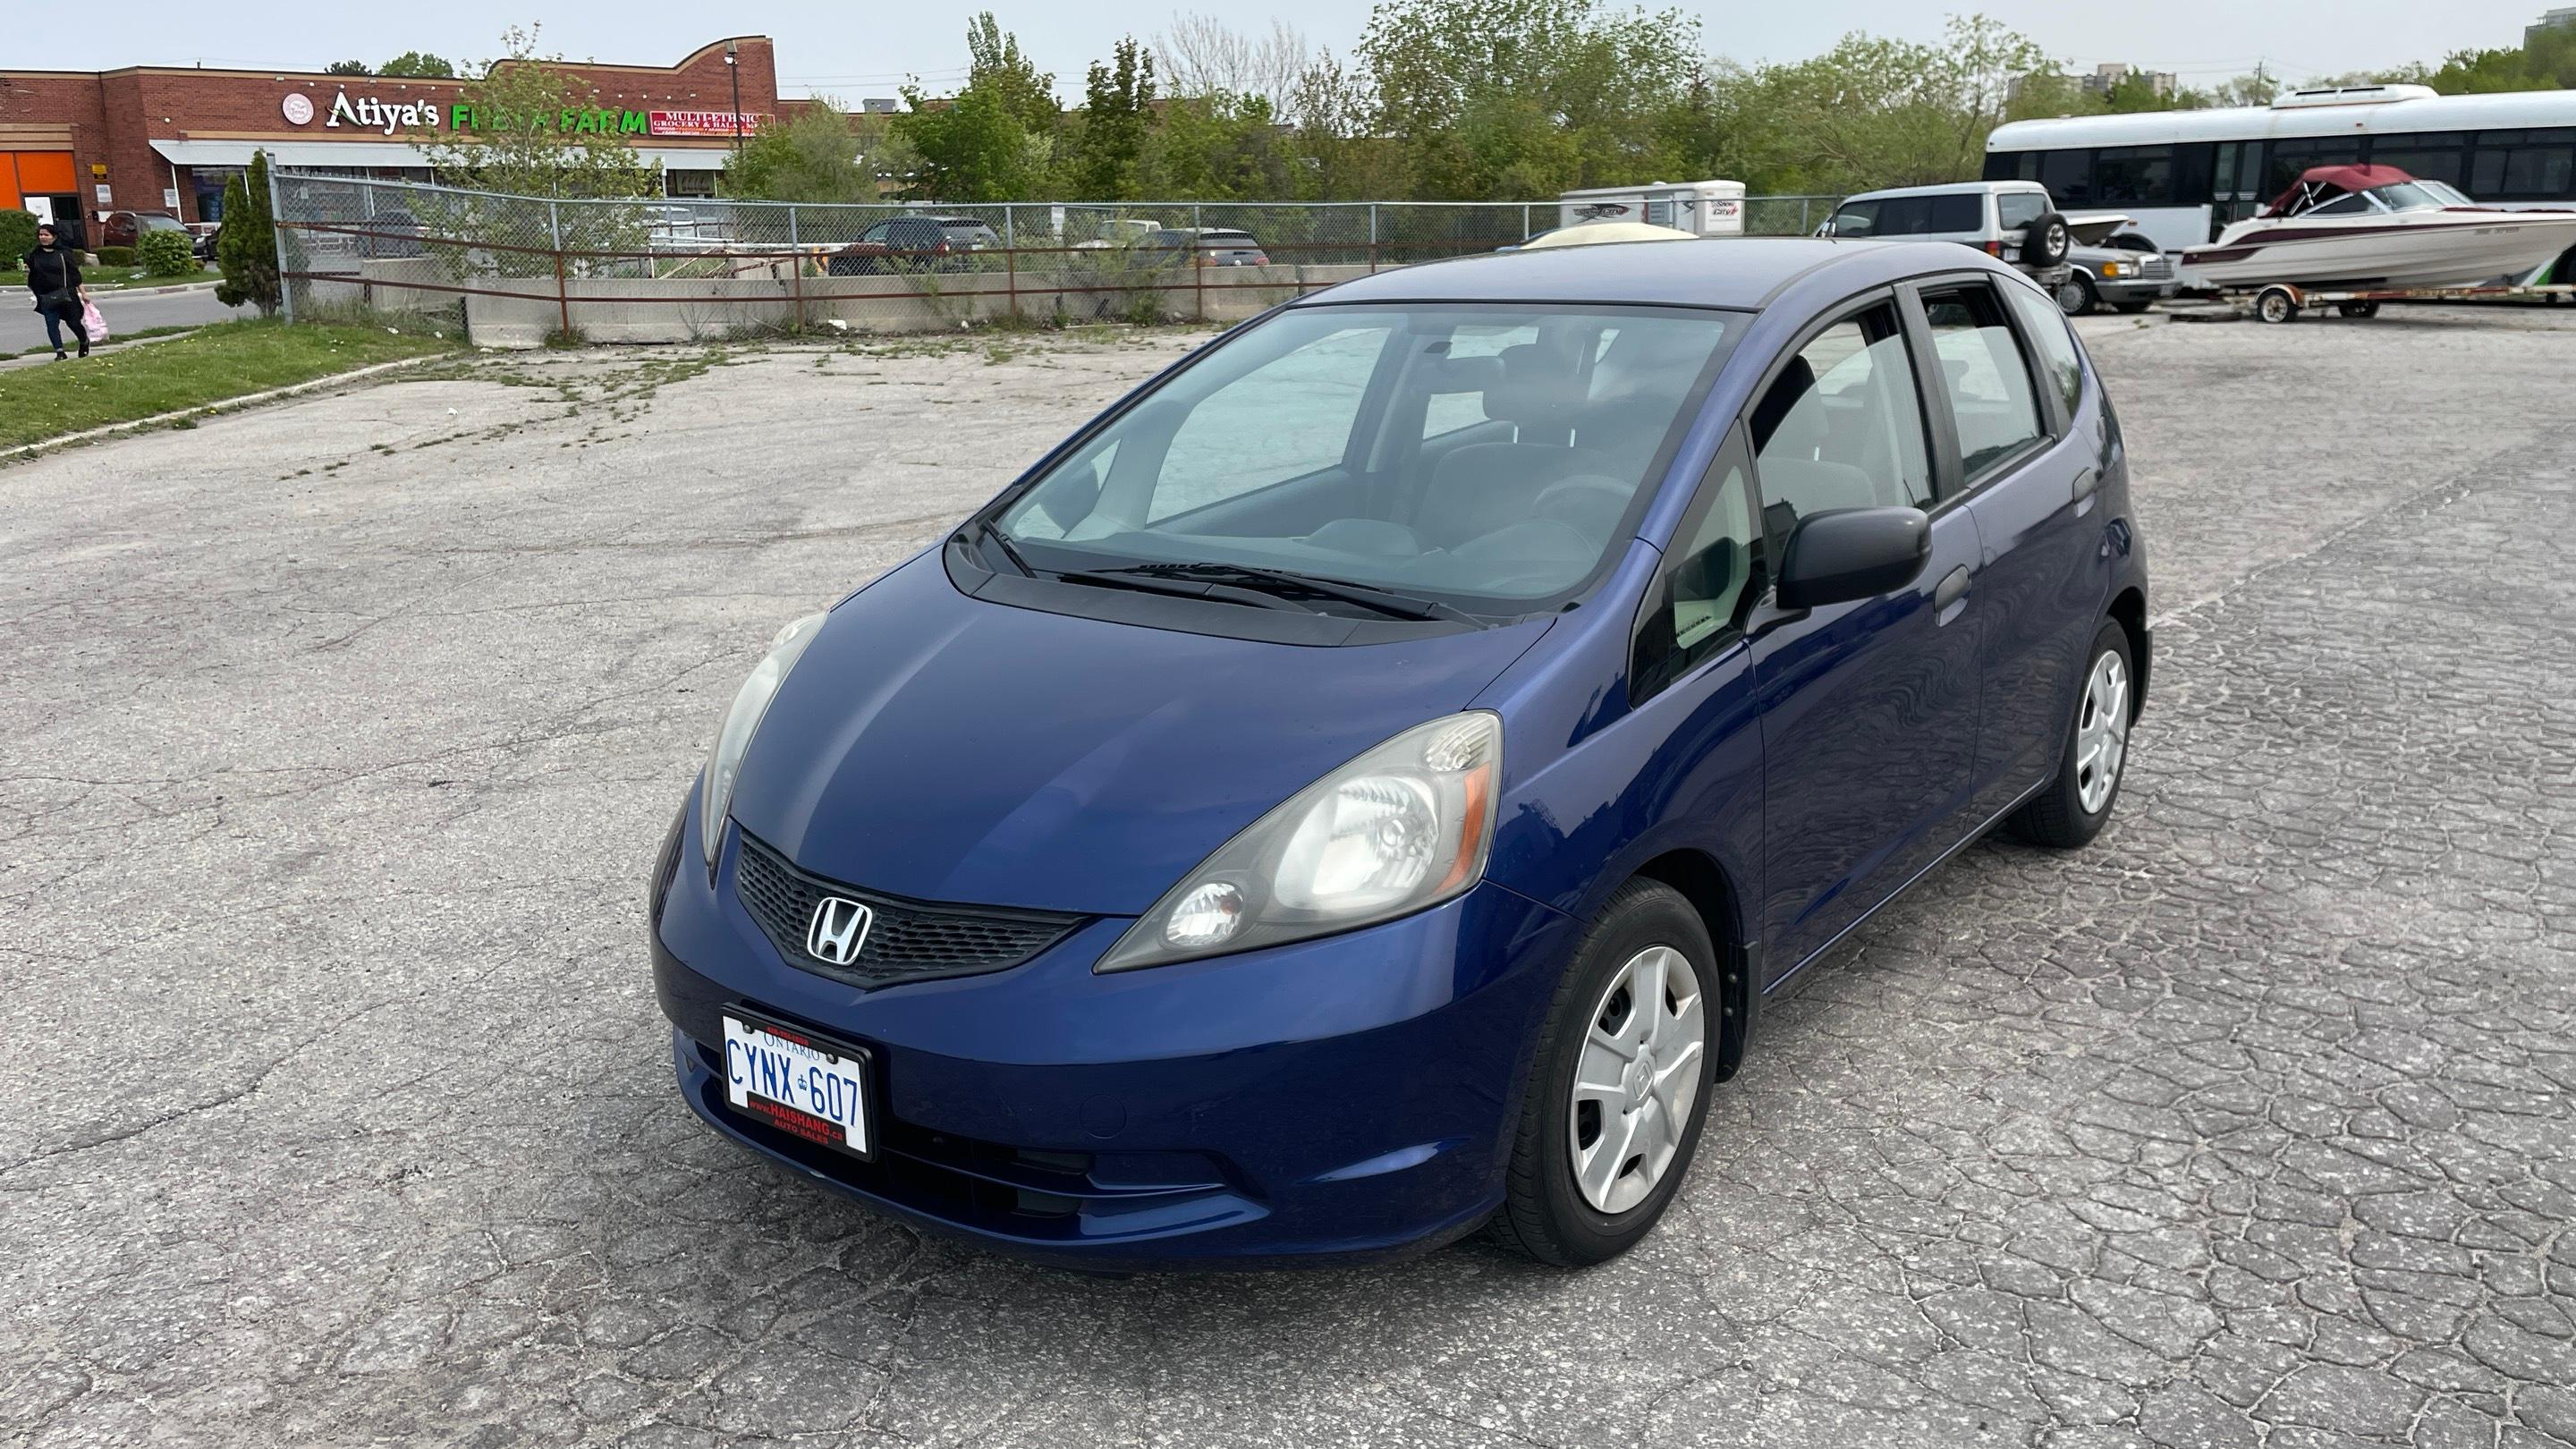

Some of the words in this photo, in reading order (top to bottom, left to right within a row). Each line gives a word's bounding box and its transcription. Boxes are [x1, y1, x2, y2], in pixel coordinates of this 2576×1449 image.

[326, 91, 439, 135] Atiya's
[560, 108, 647, 135] FARM
[653, 120, 700, 128] GROCERY
[714, 121, 744, 129] HALA
[764, 1031, 820, 1062] ONTARIO
[726, 1038, 795, 1105] CYNX
[809, 1066, 858, 1127] 607
[775, 1119, 798, 1133] AUTO
[800, 1128, 829, 1145] SALES
